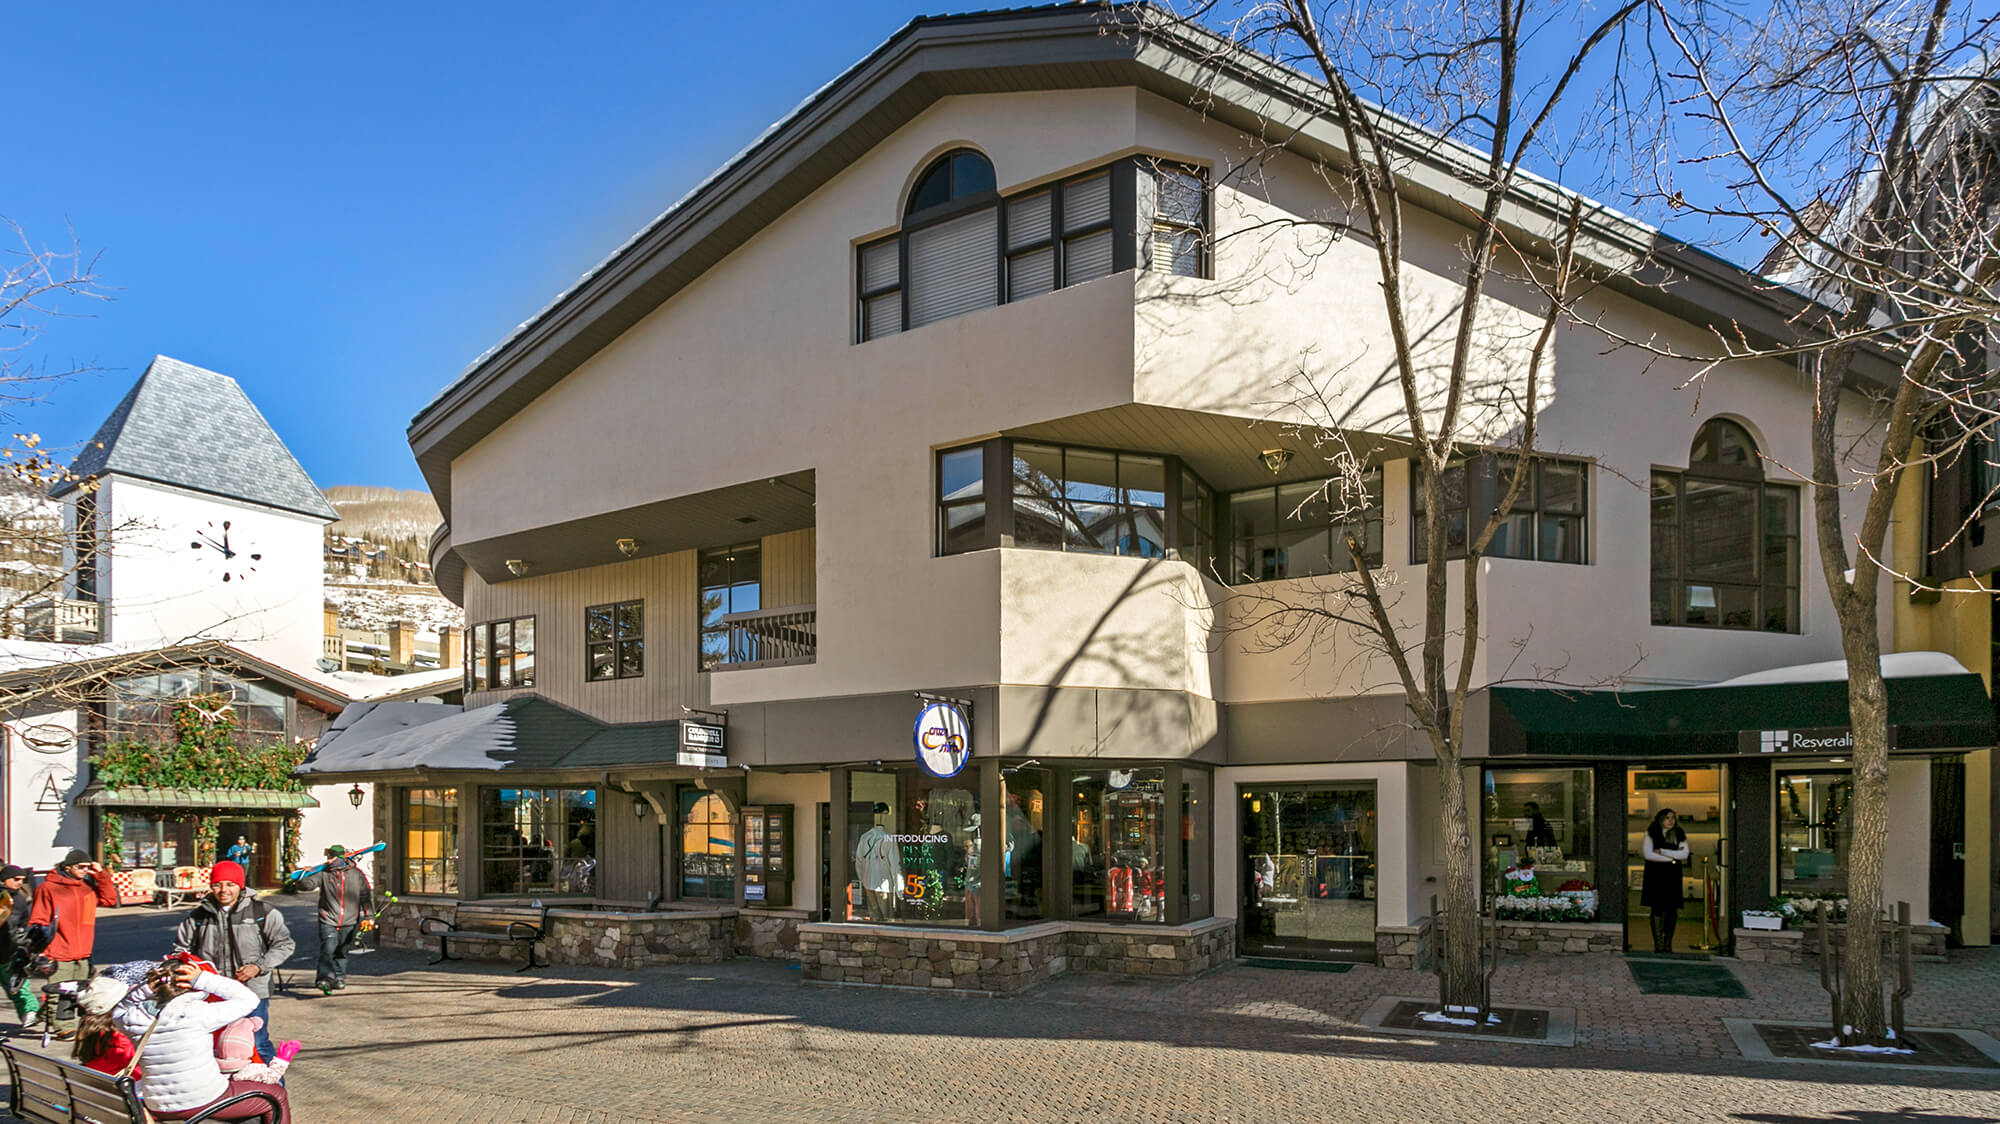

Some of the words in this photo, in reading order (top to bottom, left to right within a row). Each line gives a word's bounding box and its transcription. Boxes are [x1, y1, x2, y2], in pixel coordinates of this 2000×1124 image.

[1793, 731, 1853, 748] Resverali
[884, 834, 949, 844] INTRODUCING
[904, 874, 925, 898] 55
